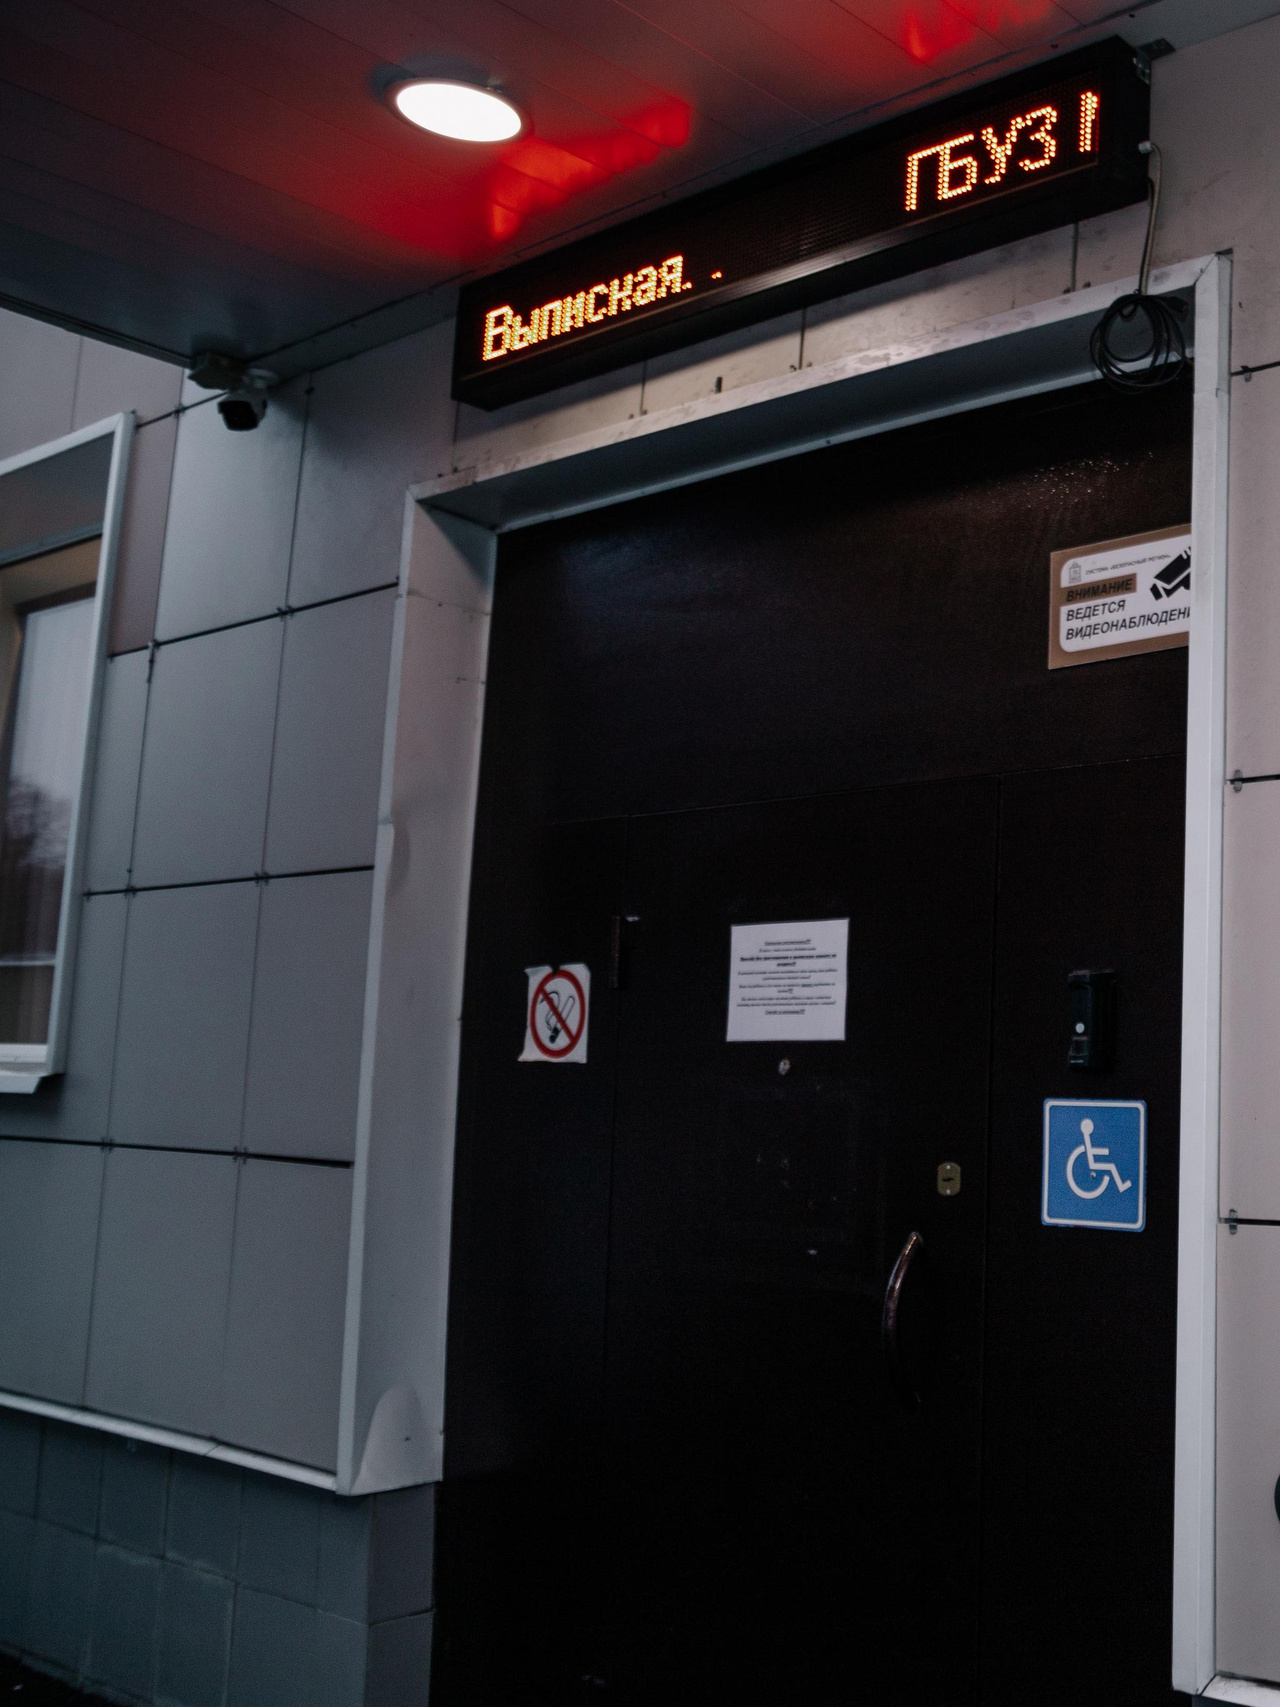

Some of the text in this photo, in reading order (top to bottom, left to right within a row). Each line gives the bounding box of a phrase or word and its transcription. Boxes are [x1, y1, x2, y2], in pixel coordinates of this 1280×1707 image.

[904, 104, 1058, 212] ГБУЗ
[1065, 577, 1134, 603] ВНИМАНИЕ
[1065, 600, 1127, 622] ВЕДЕТСЯ
